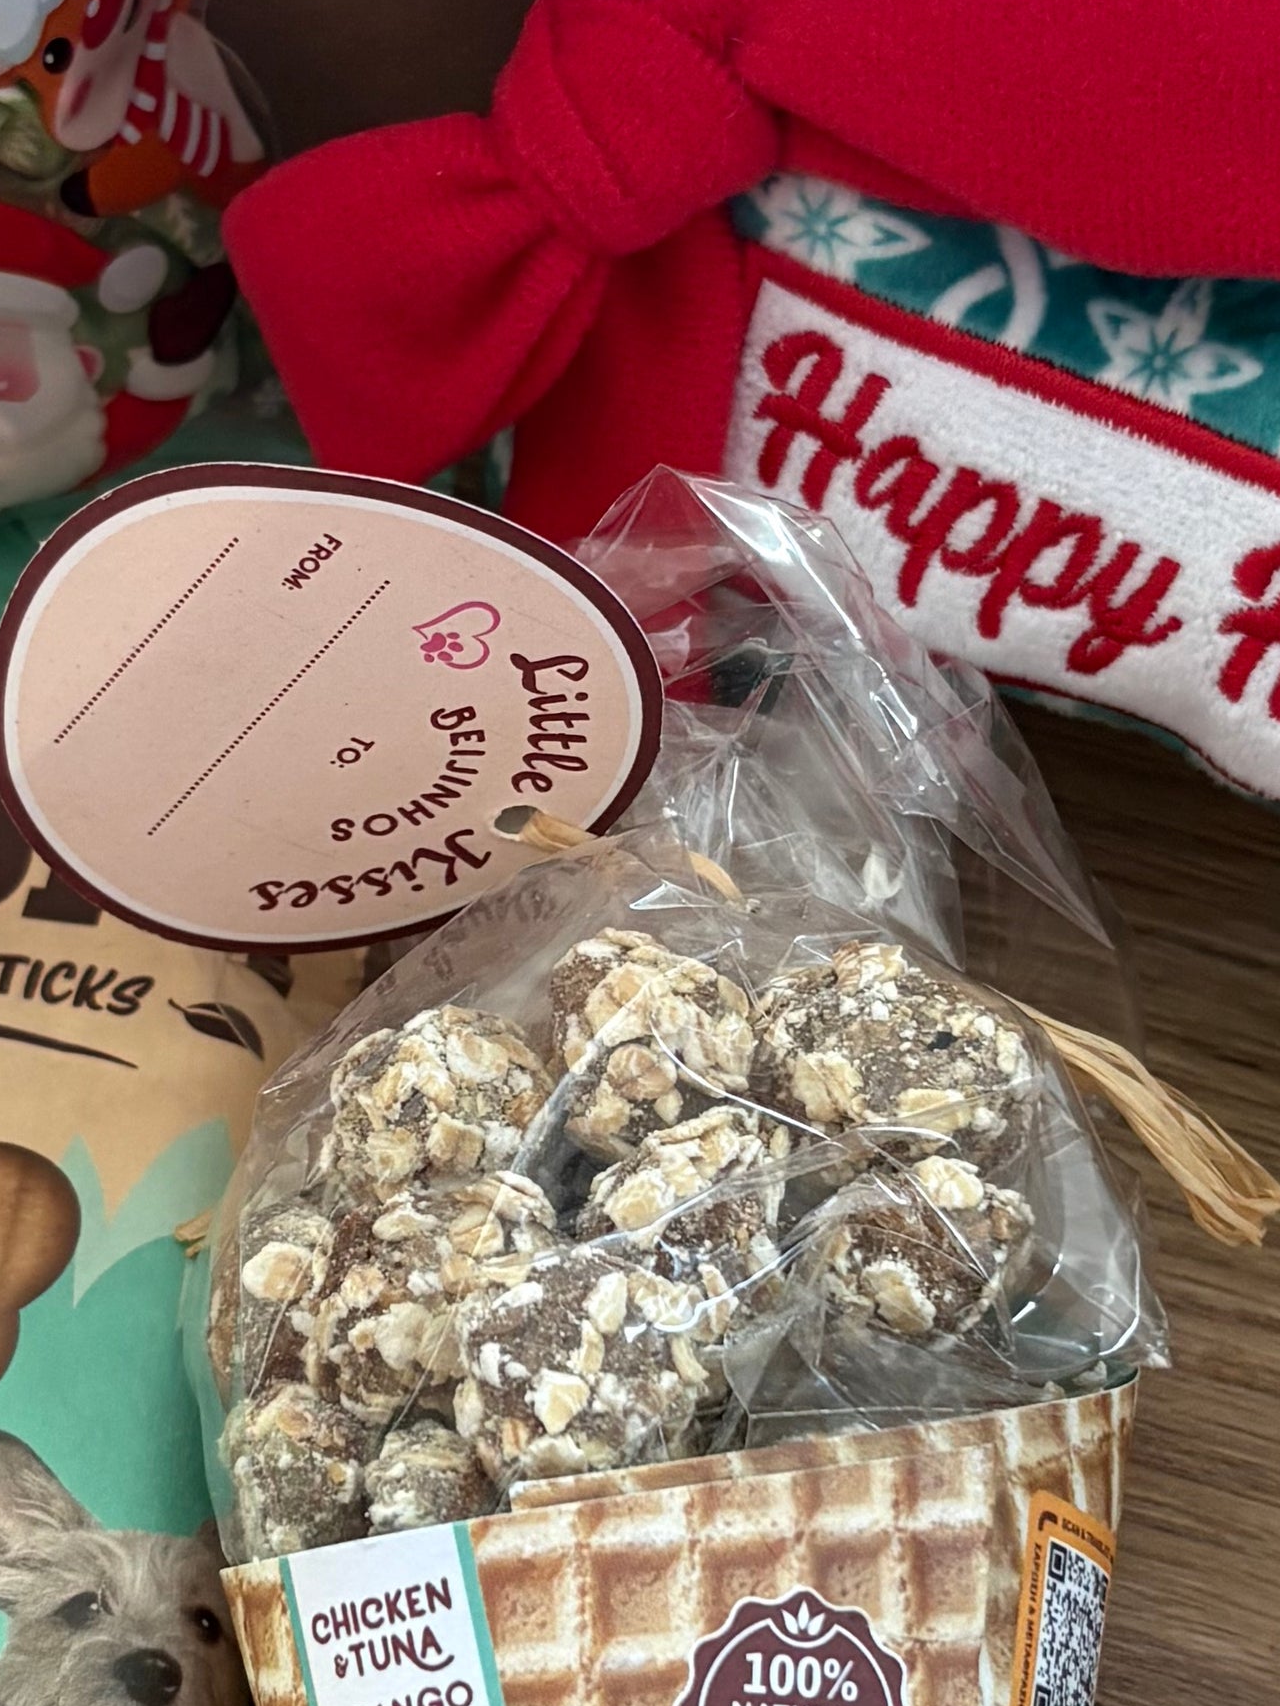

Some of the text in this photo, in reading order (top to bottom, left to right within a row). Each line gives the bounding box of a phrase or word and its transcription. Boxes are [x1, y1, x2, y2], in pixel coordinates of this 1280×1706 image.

[751, 328, 1182, 675] Happy
[281, 532, 342, 592] FROM:
[248, 652, 590, 912] Little Kisses
[328, 735, 375, 770] TO:
[329, 705, 486, 842] BEIJINHOS
[311, 1577, 452, 1645] CHICKEN
[743, 1652, 858, 1702] 100%
